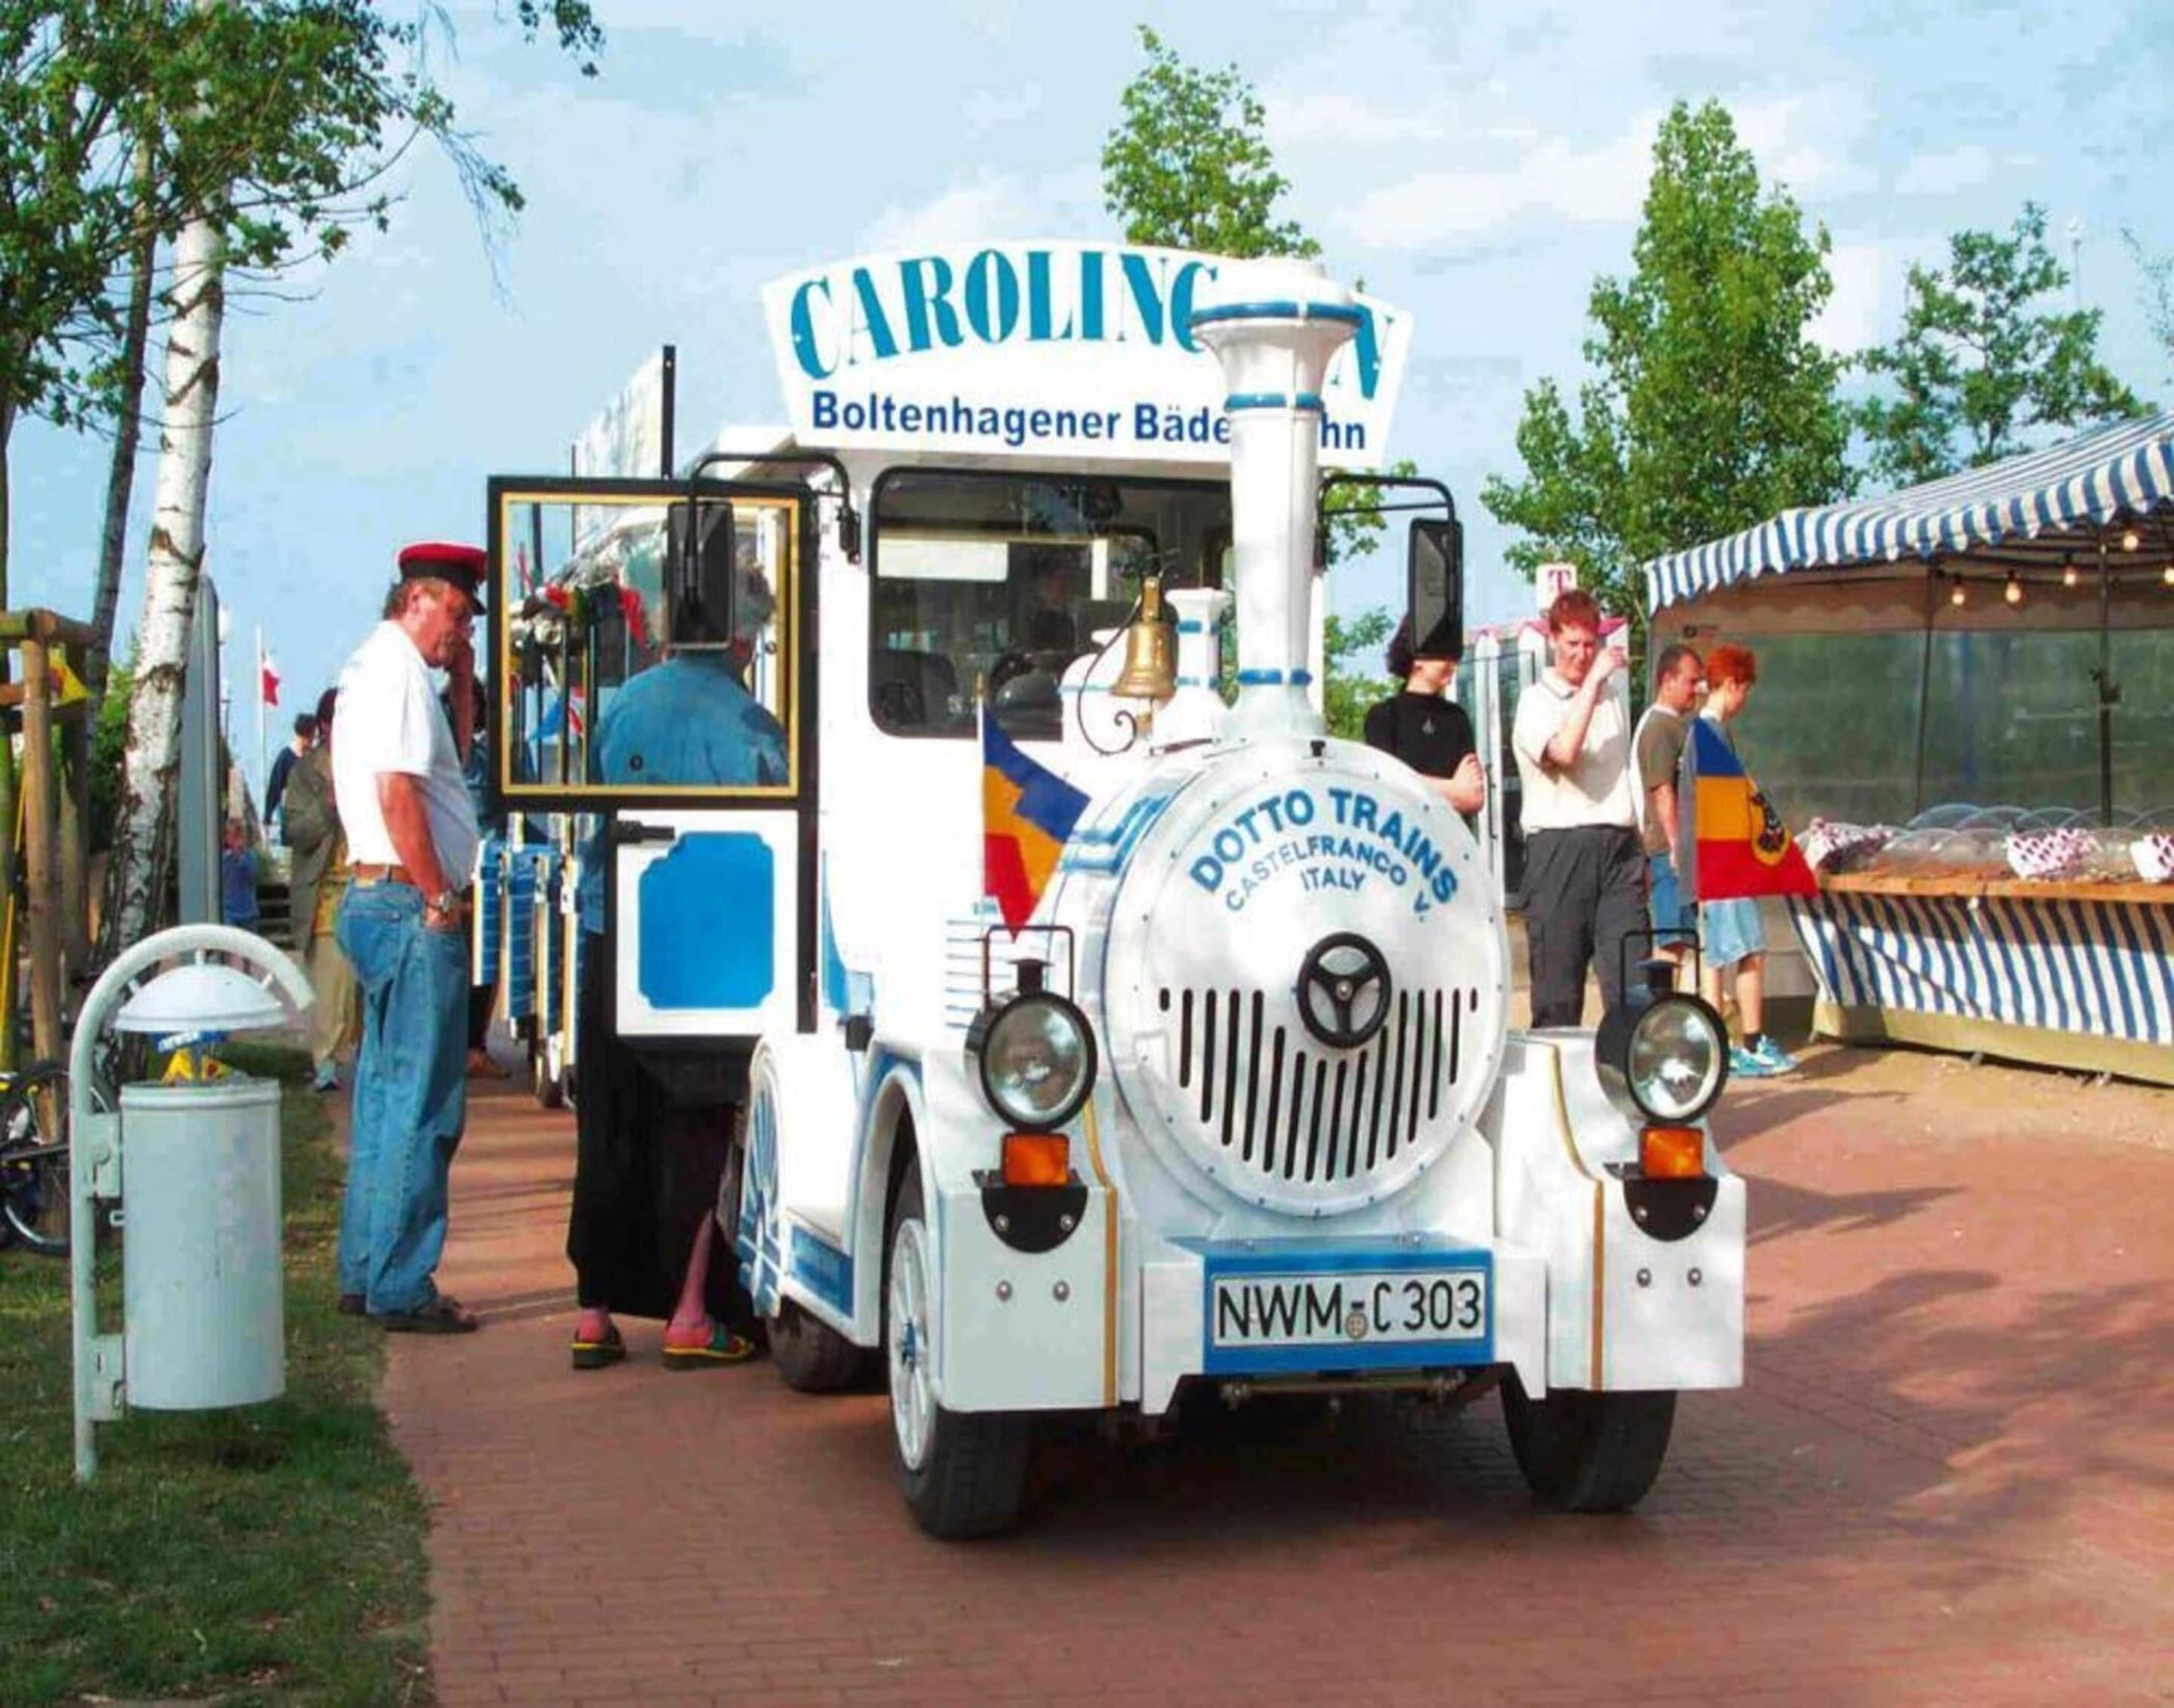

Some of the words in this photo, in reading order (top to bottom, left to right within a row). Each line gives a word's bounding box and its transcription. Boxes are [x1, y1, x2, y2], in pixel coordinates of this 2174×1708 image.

[790, 248, 1394, 399] CAROLINCN
[812, 390, 1121, 446] Boltenhagener
[1134, 402, 1365, 450] Bädehn
[1189, 789, 1314, 893] DOTTO
[1327, 787, 1458, 904] TRAINS
[1224, 834, 1407, 912] CASTELFRANCO
[1301, 866, 1365, 891] ITALY
[1403, 1280, 1481, 1331] 303
